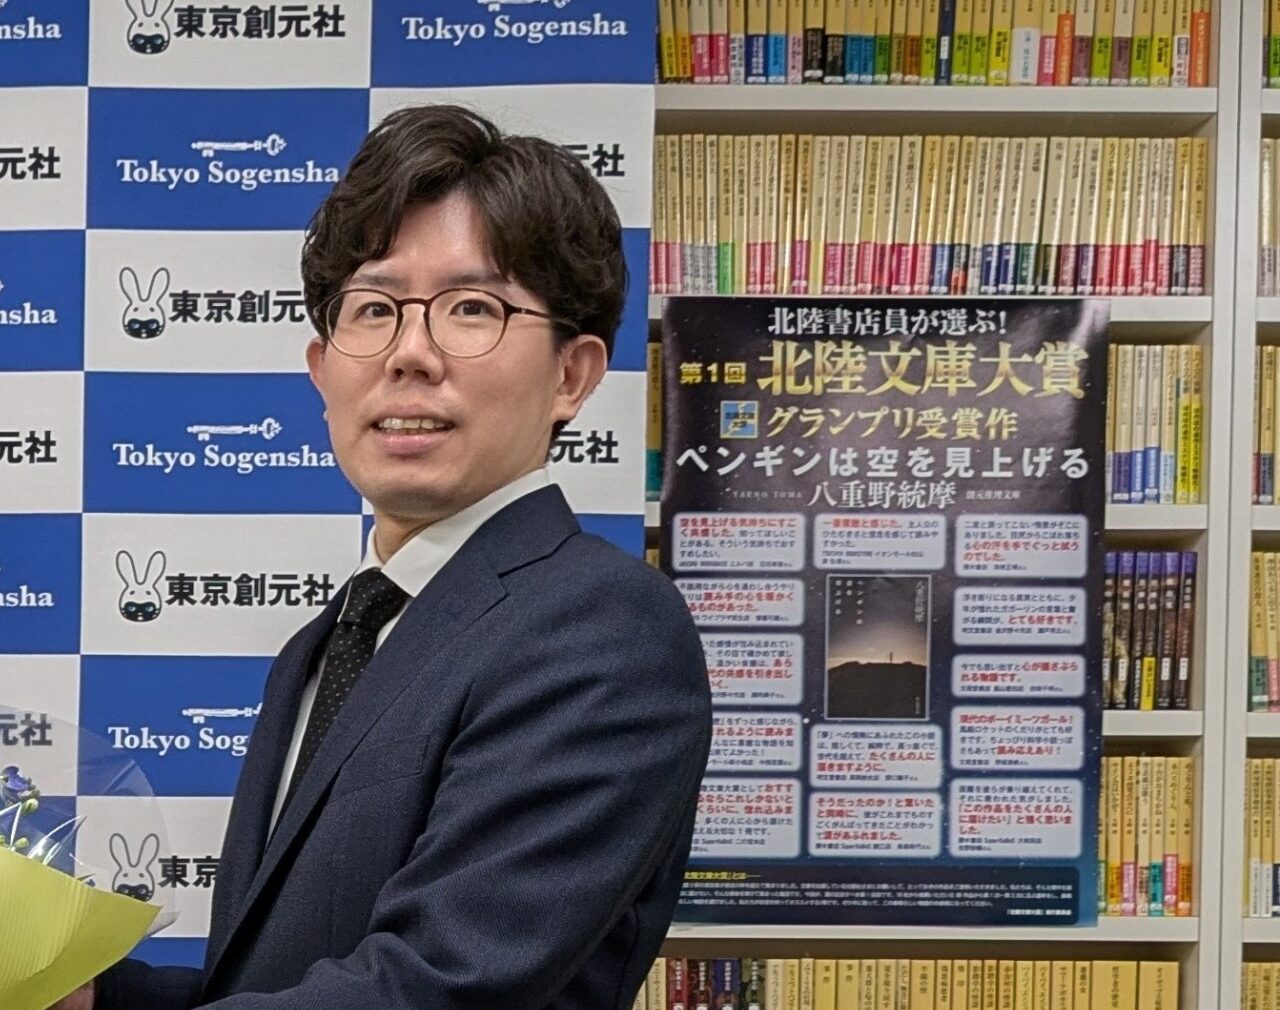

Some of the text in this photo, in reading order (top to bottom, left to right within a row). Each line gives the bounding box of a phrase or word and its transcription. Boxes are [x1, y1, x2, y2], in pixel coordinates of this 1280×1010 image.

[174, 5, 345, 38] 東京創元社
[402, 13, 627, 46] Tokyo Sogensha
[117, 160, 339, 190] Tokyo Sogensha
[169, 290, 304, 323] 東京創元
[680, 362, 747, 384] 第1回
[756, 340, 1089, 399] 北陸文庫大賞
[766, 406, 1019, 440] グランプリ受賞作
[113, 444, 334, 473] Tokyo Sogensha
[675, 446, 1089, 478] ペンギンは空を見上げる
[808, 481, 956, 510] 八重野統摩
[166, 573, 334, 606] 東京創元社
[108, 727, 190, 755] Tokyo
